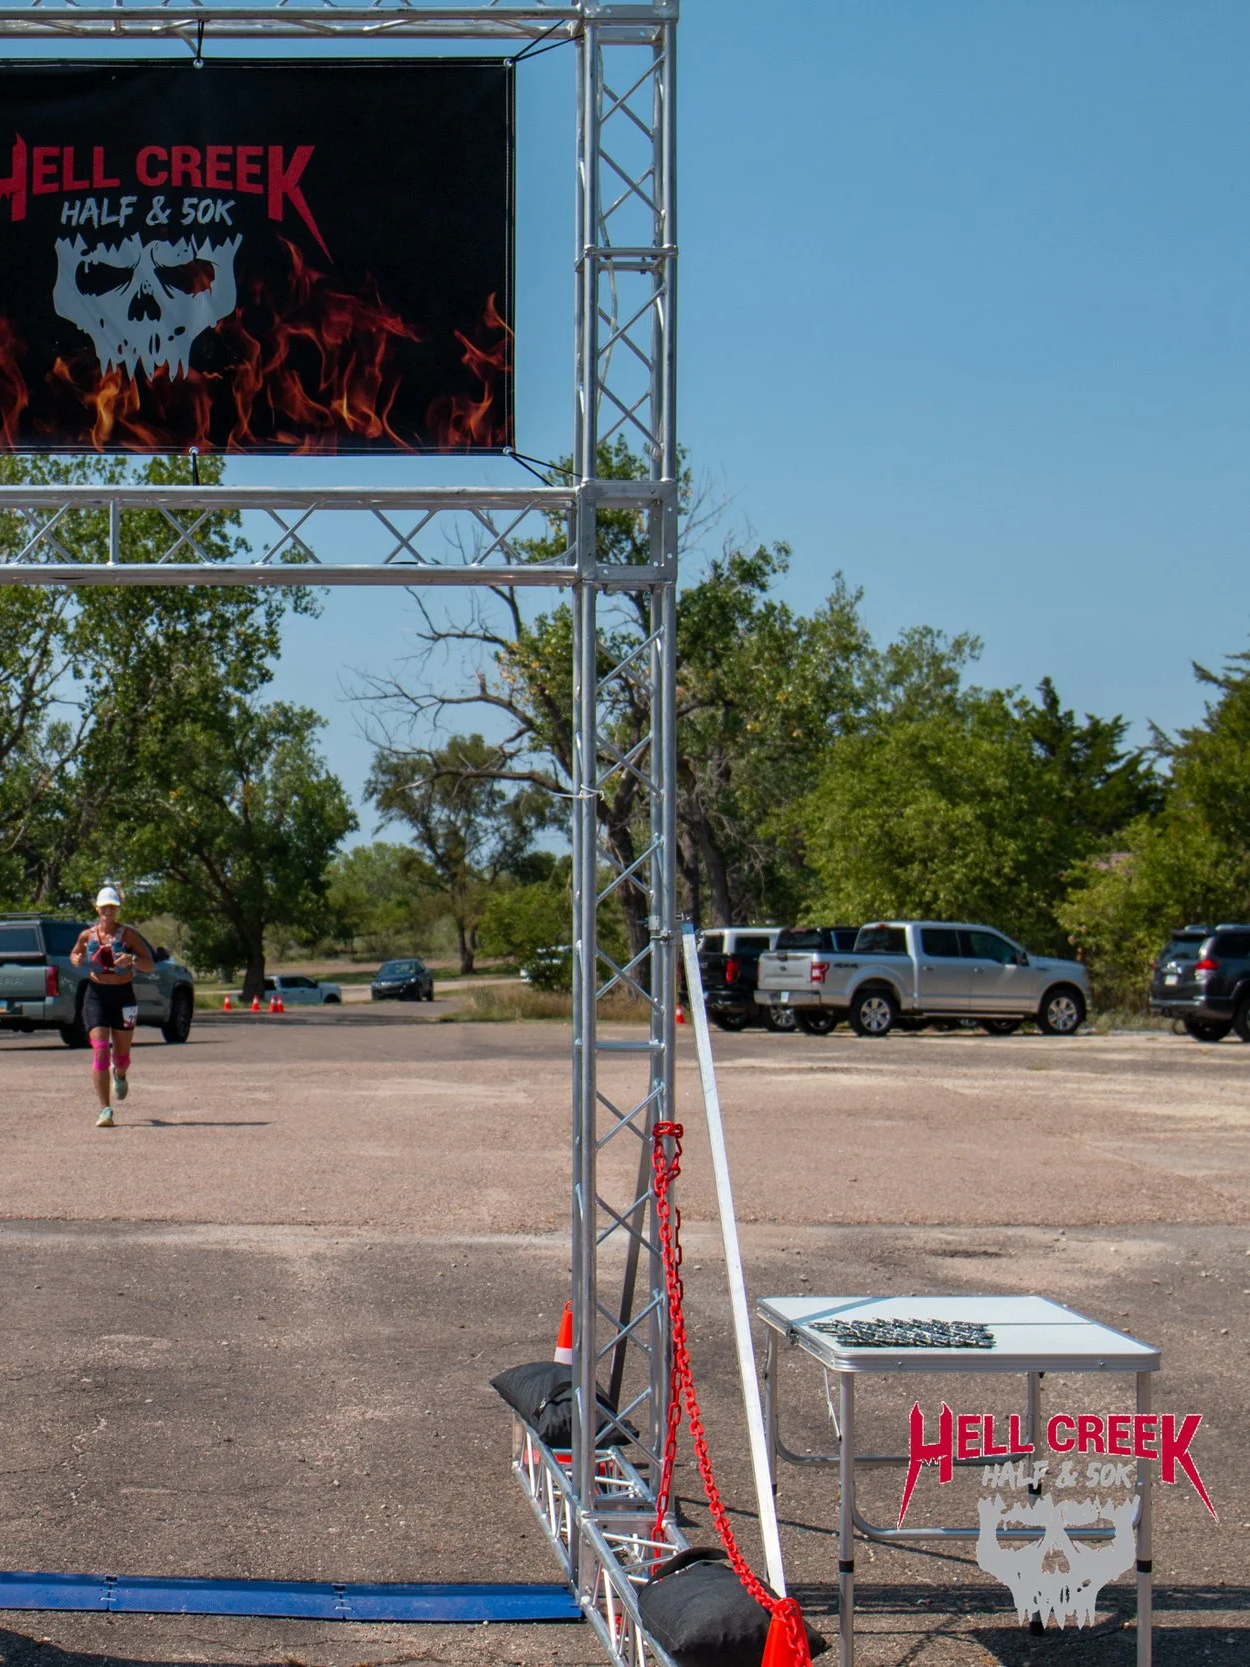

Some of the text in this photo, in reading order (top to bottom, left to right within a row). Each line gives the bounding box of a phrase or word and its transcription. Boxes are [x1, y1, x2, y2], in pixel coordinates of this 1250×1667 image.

[61, 196, 236, 228] HALF & 50K
[136, 145, 333, 263] CREEK
